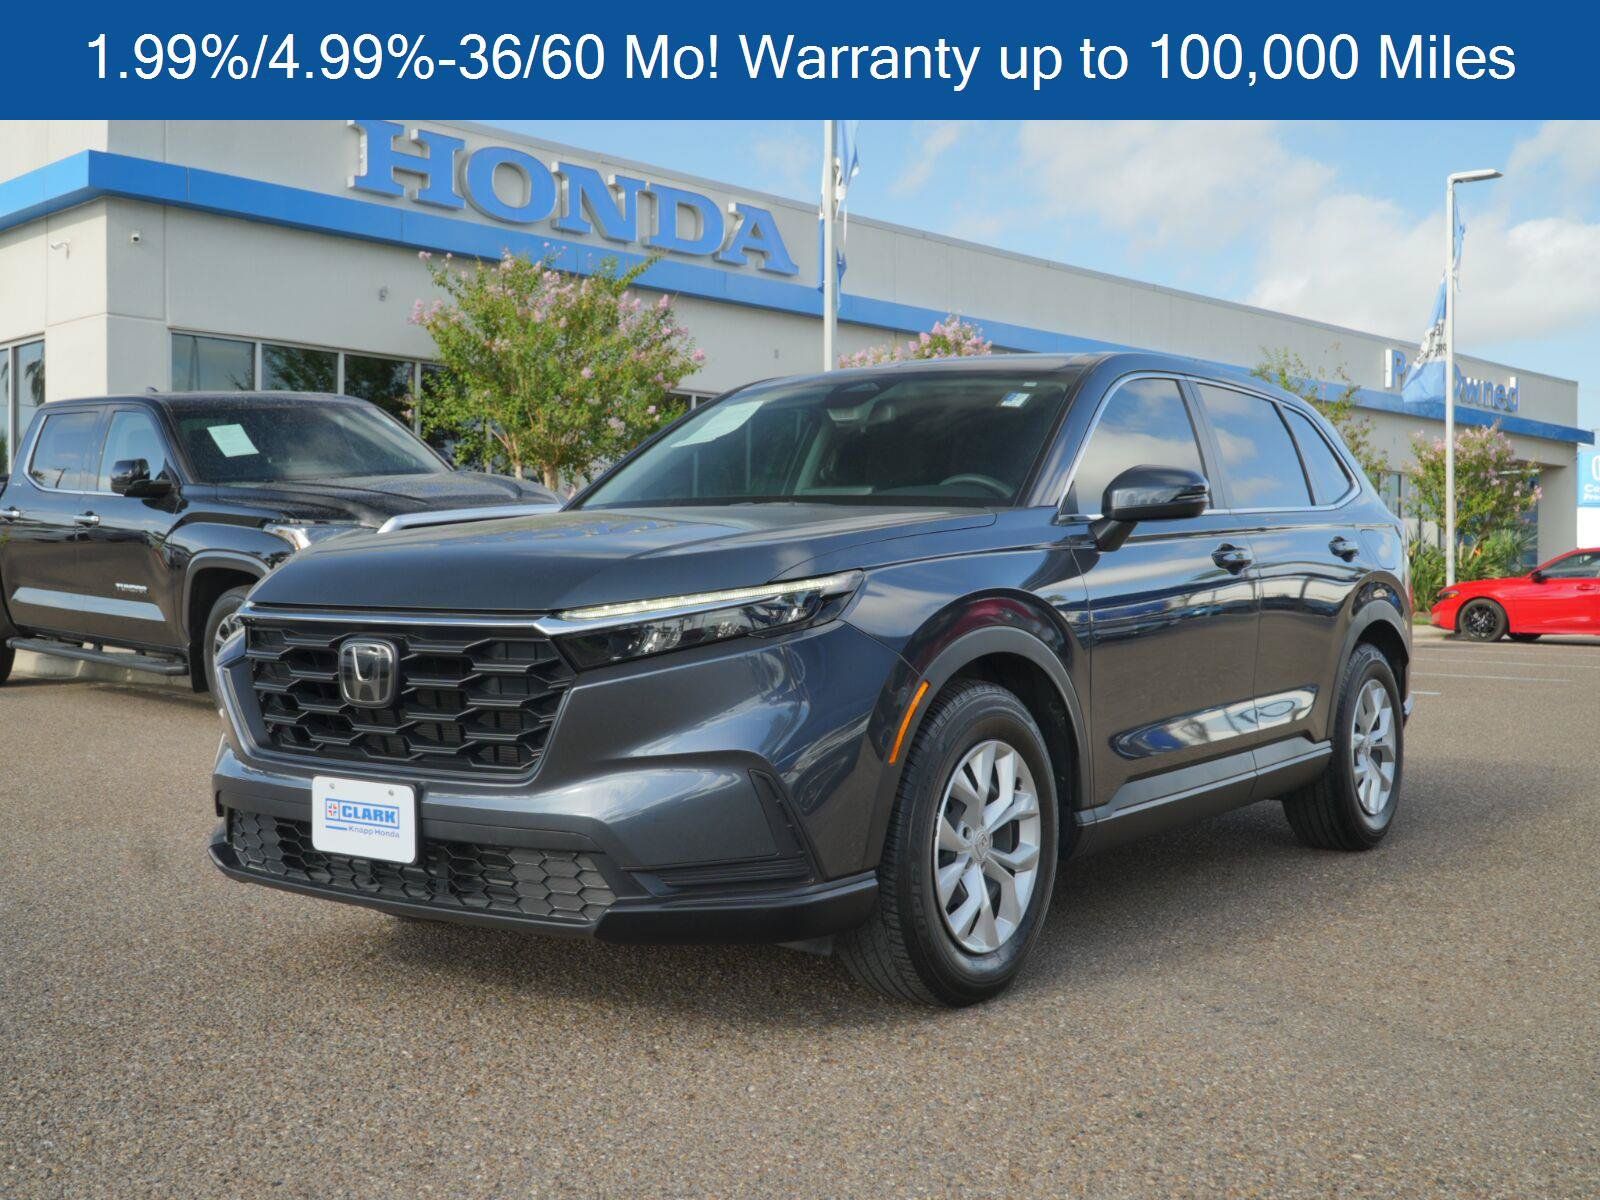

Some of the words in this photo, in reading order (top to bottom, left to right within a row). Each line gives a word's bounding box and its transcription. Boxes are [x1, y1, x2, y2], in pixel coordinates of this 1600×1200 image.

[347, 119, 799, 276] HONDA
[341, 805, 396, 824] CLARK
[348, 826, 374, 836] Knapp
[374, 829, 400, 839] Honda
